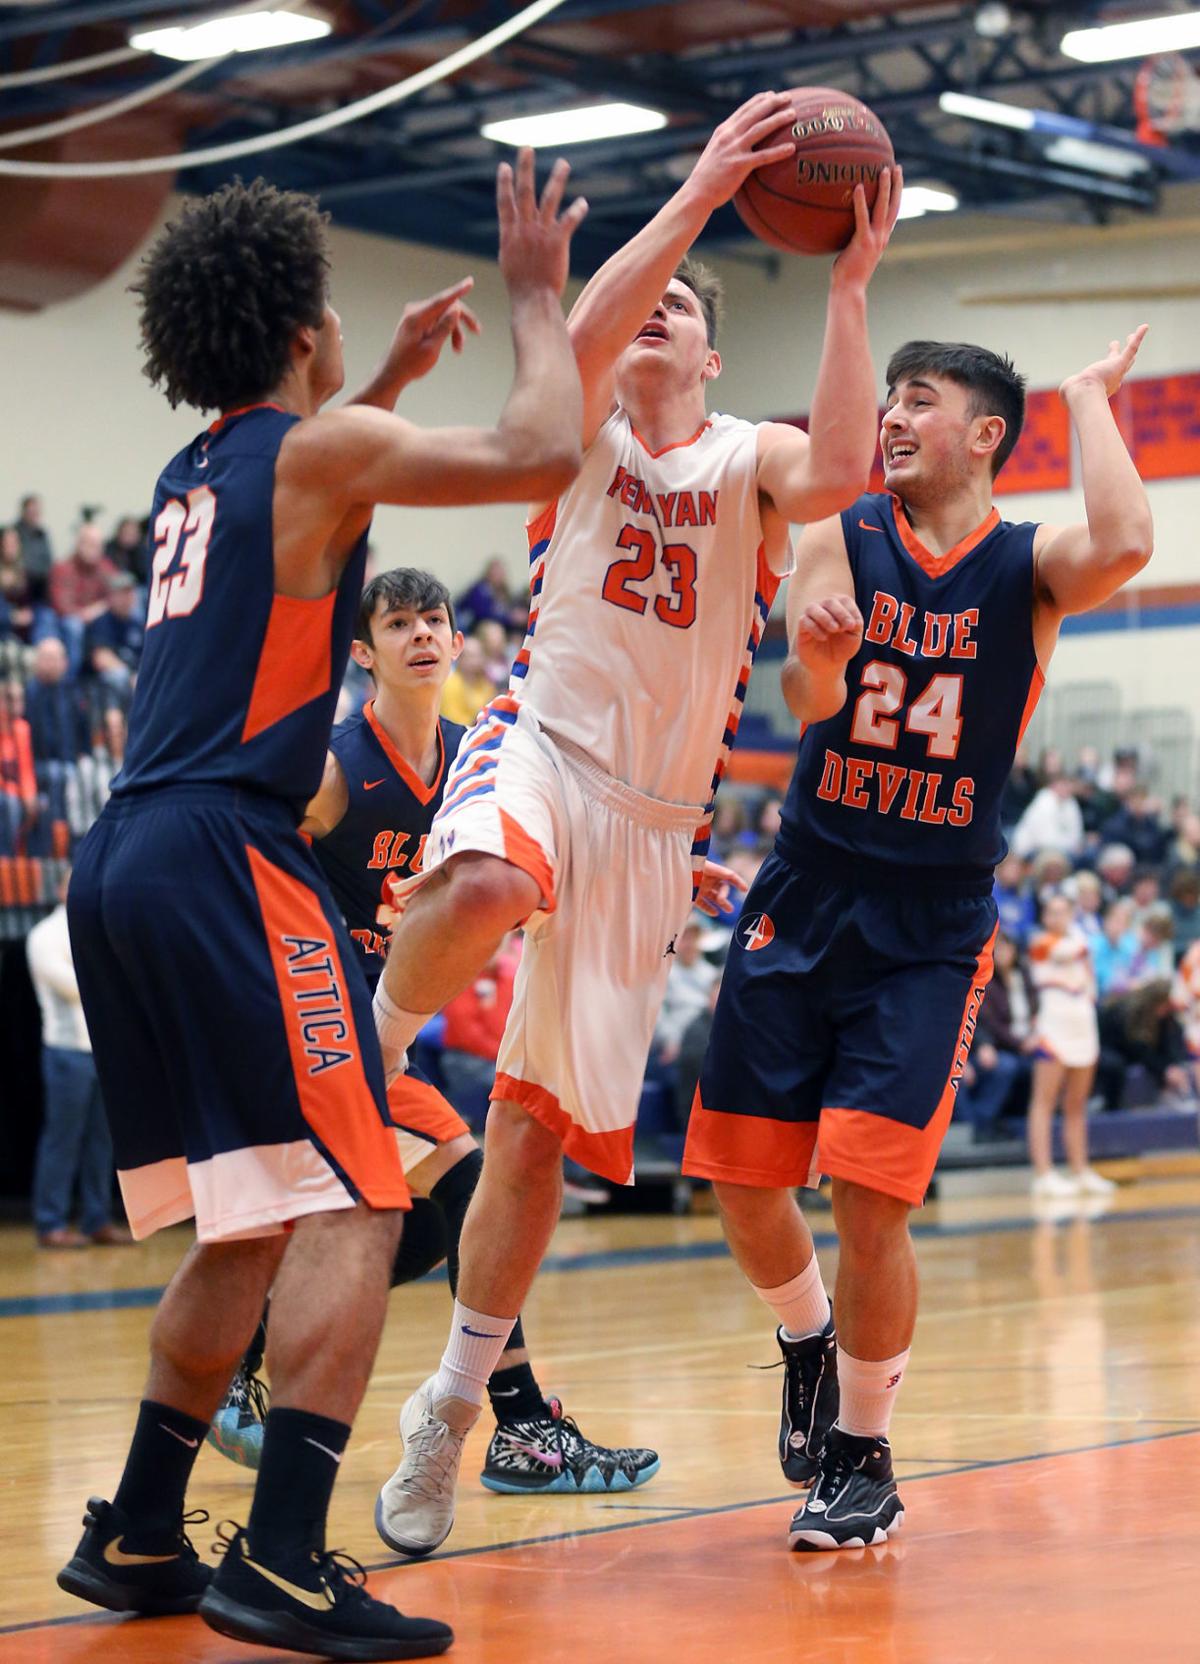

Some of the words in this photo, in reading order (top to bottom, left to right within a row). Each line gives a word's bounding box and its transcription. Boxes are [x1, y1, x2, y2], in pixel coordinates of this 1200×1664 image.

[797, 159, 888, 185] ALDING
[656, 490, 719, 527] YAN
[145, 484, 217, 632] 23
[602, 523, 698, 629] 23
[865, 591, 979, 659] BLUE
[850, 659, 964, 760] 24
[817, 749, 975, 827] DEVILS
[367, 830, 429, 873] BLU
[281, 934, 354, 1078] ATTICA
